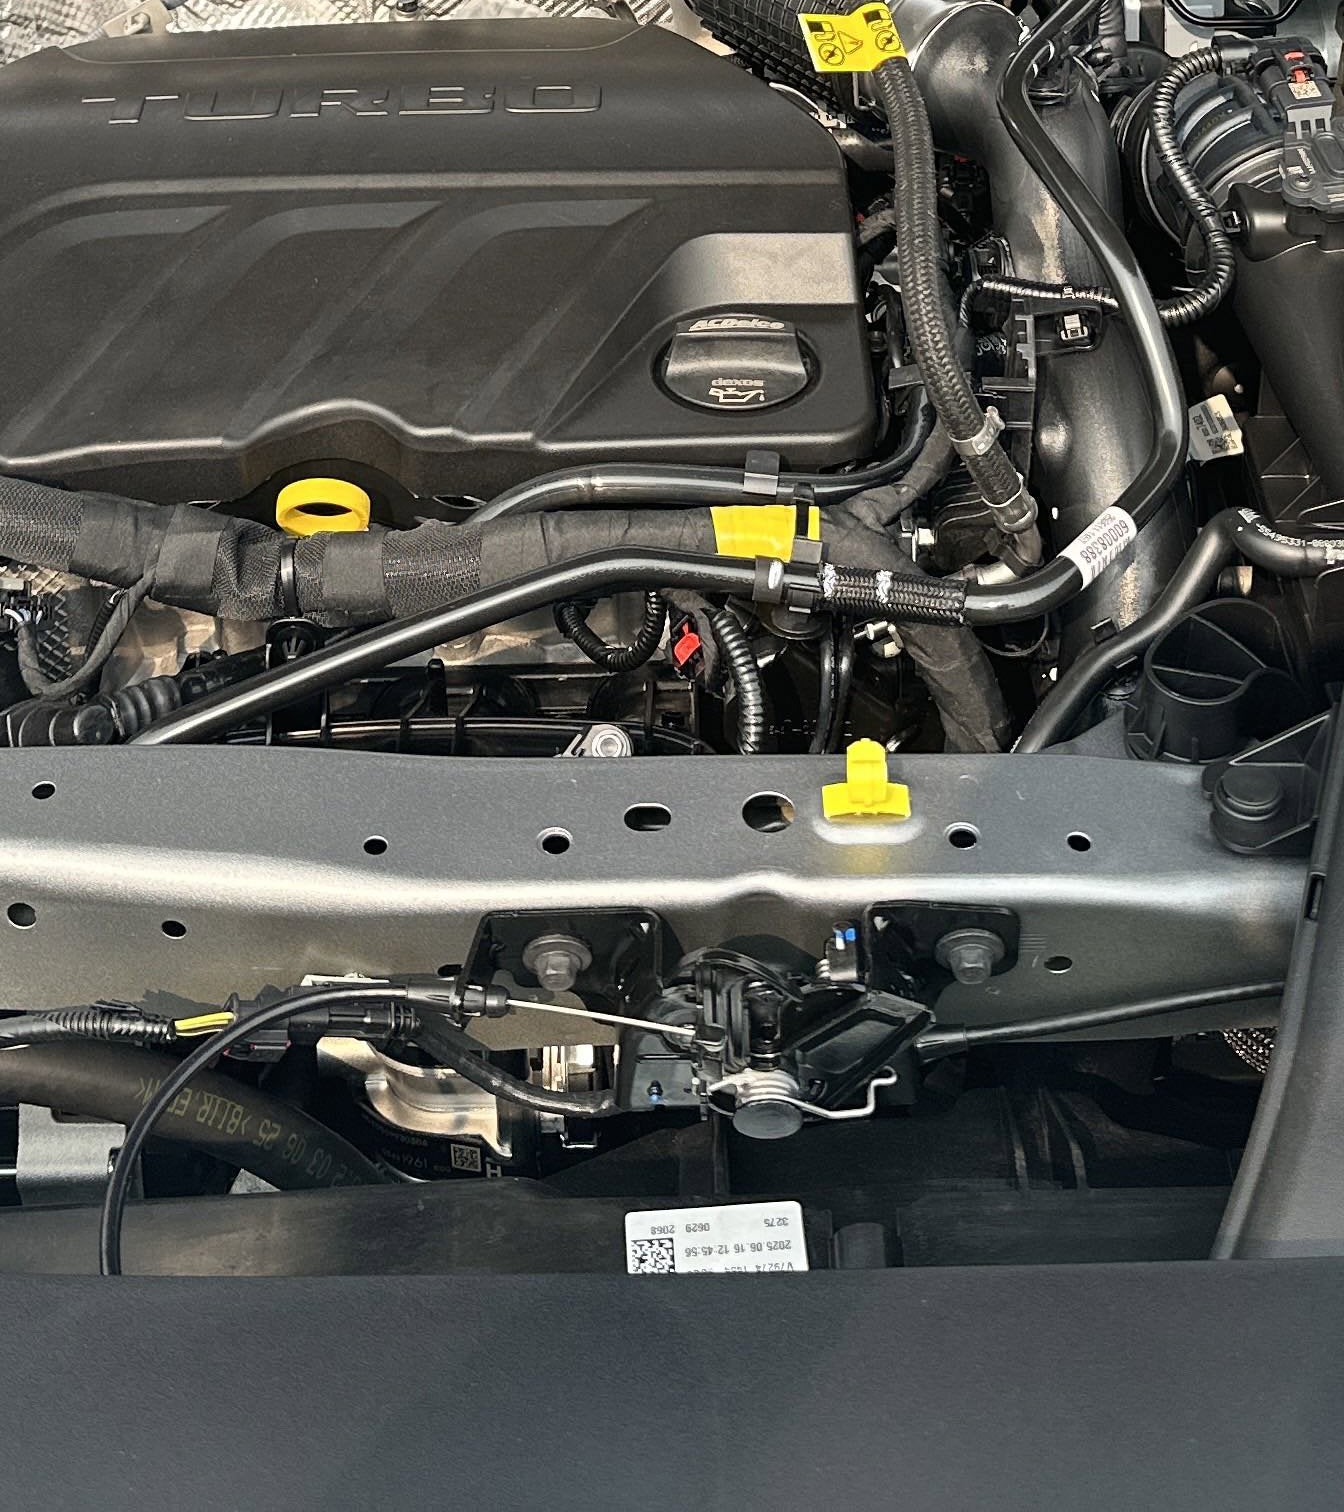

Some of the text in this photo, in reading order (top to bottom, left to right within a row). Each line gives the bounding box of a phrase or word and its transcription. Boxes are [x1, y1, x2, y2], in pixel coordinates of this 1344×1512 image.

[81, 82, 602, 125] TURBO
[688, 318, 785, 332] ACDelco
[711, 377, 765, 387] dexos
